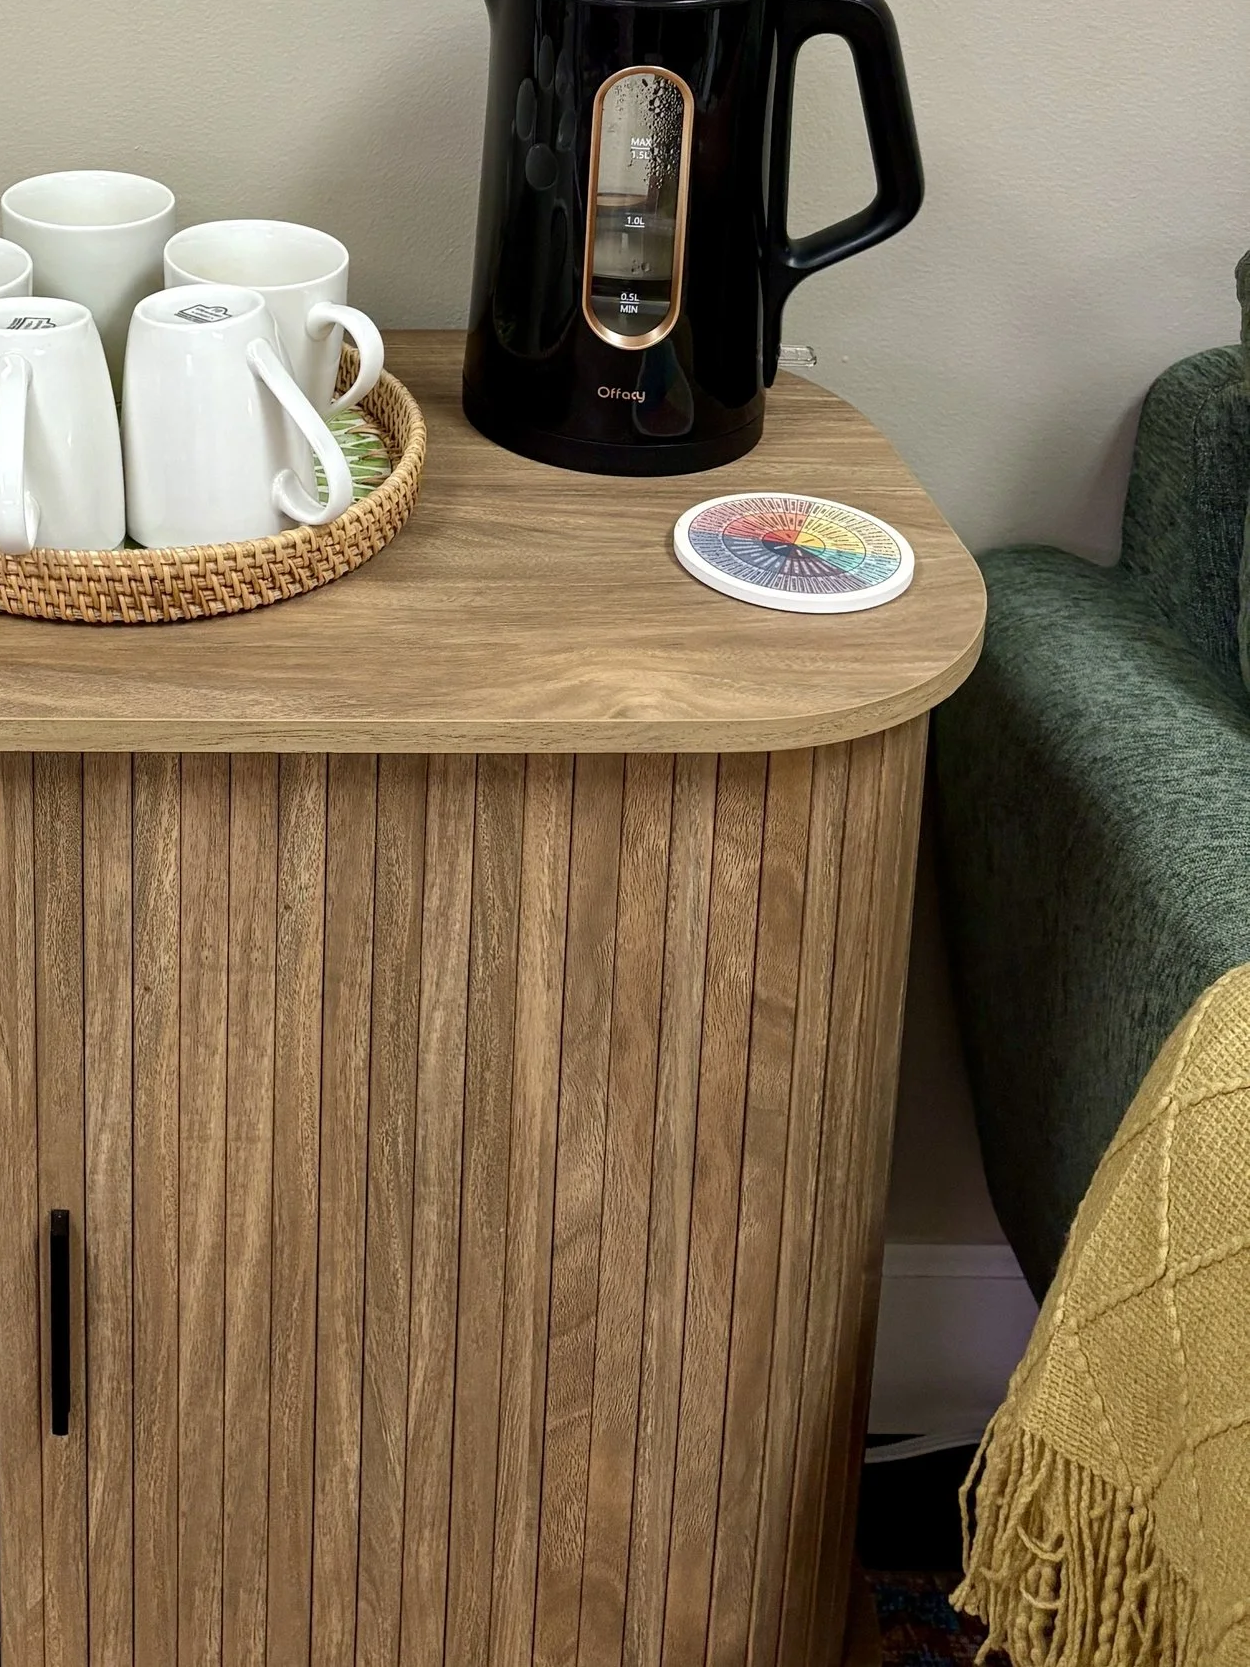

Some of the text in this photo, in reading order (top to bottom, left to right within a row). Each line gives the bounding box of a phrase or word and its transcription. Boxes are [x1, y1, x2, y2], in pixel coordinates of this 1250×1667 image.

[630, 137, 652, 147] MAX
[631, 150, 650, 159] 1.5L
[626, 216, 645, 225] 1.0L
[620, 293, 640, 302] 0.5L
[620, 304, 638, 314] MIN
[597, 386, 646, 403] Offacy
